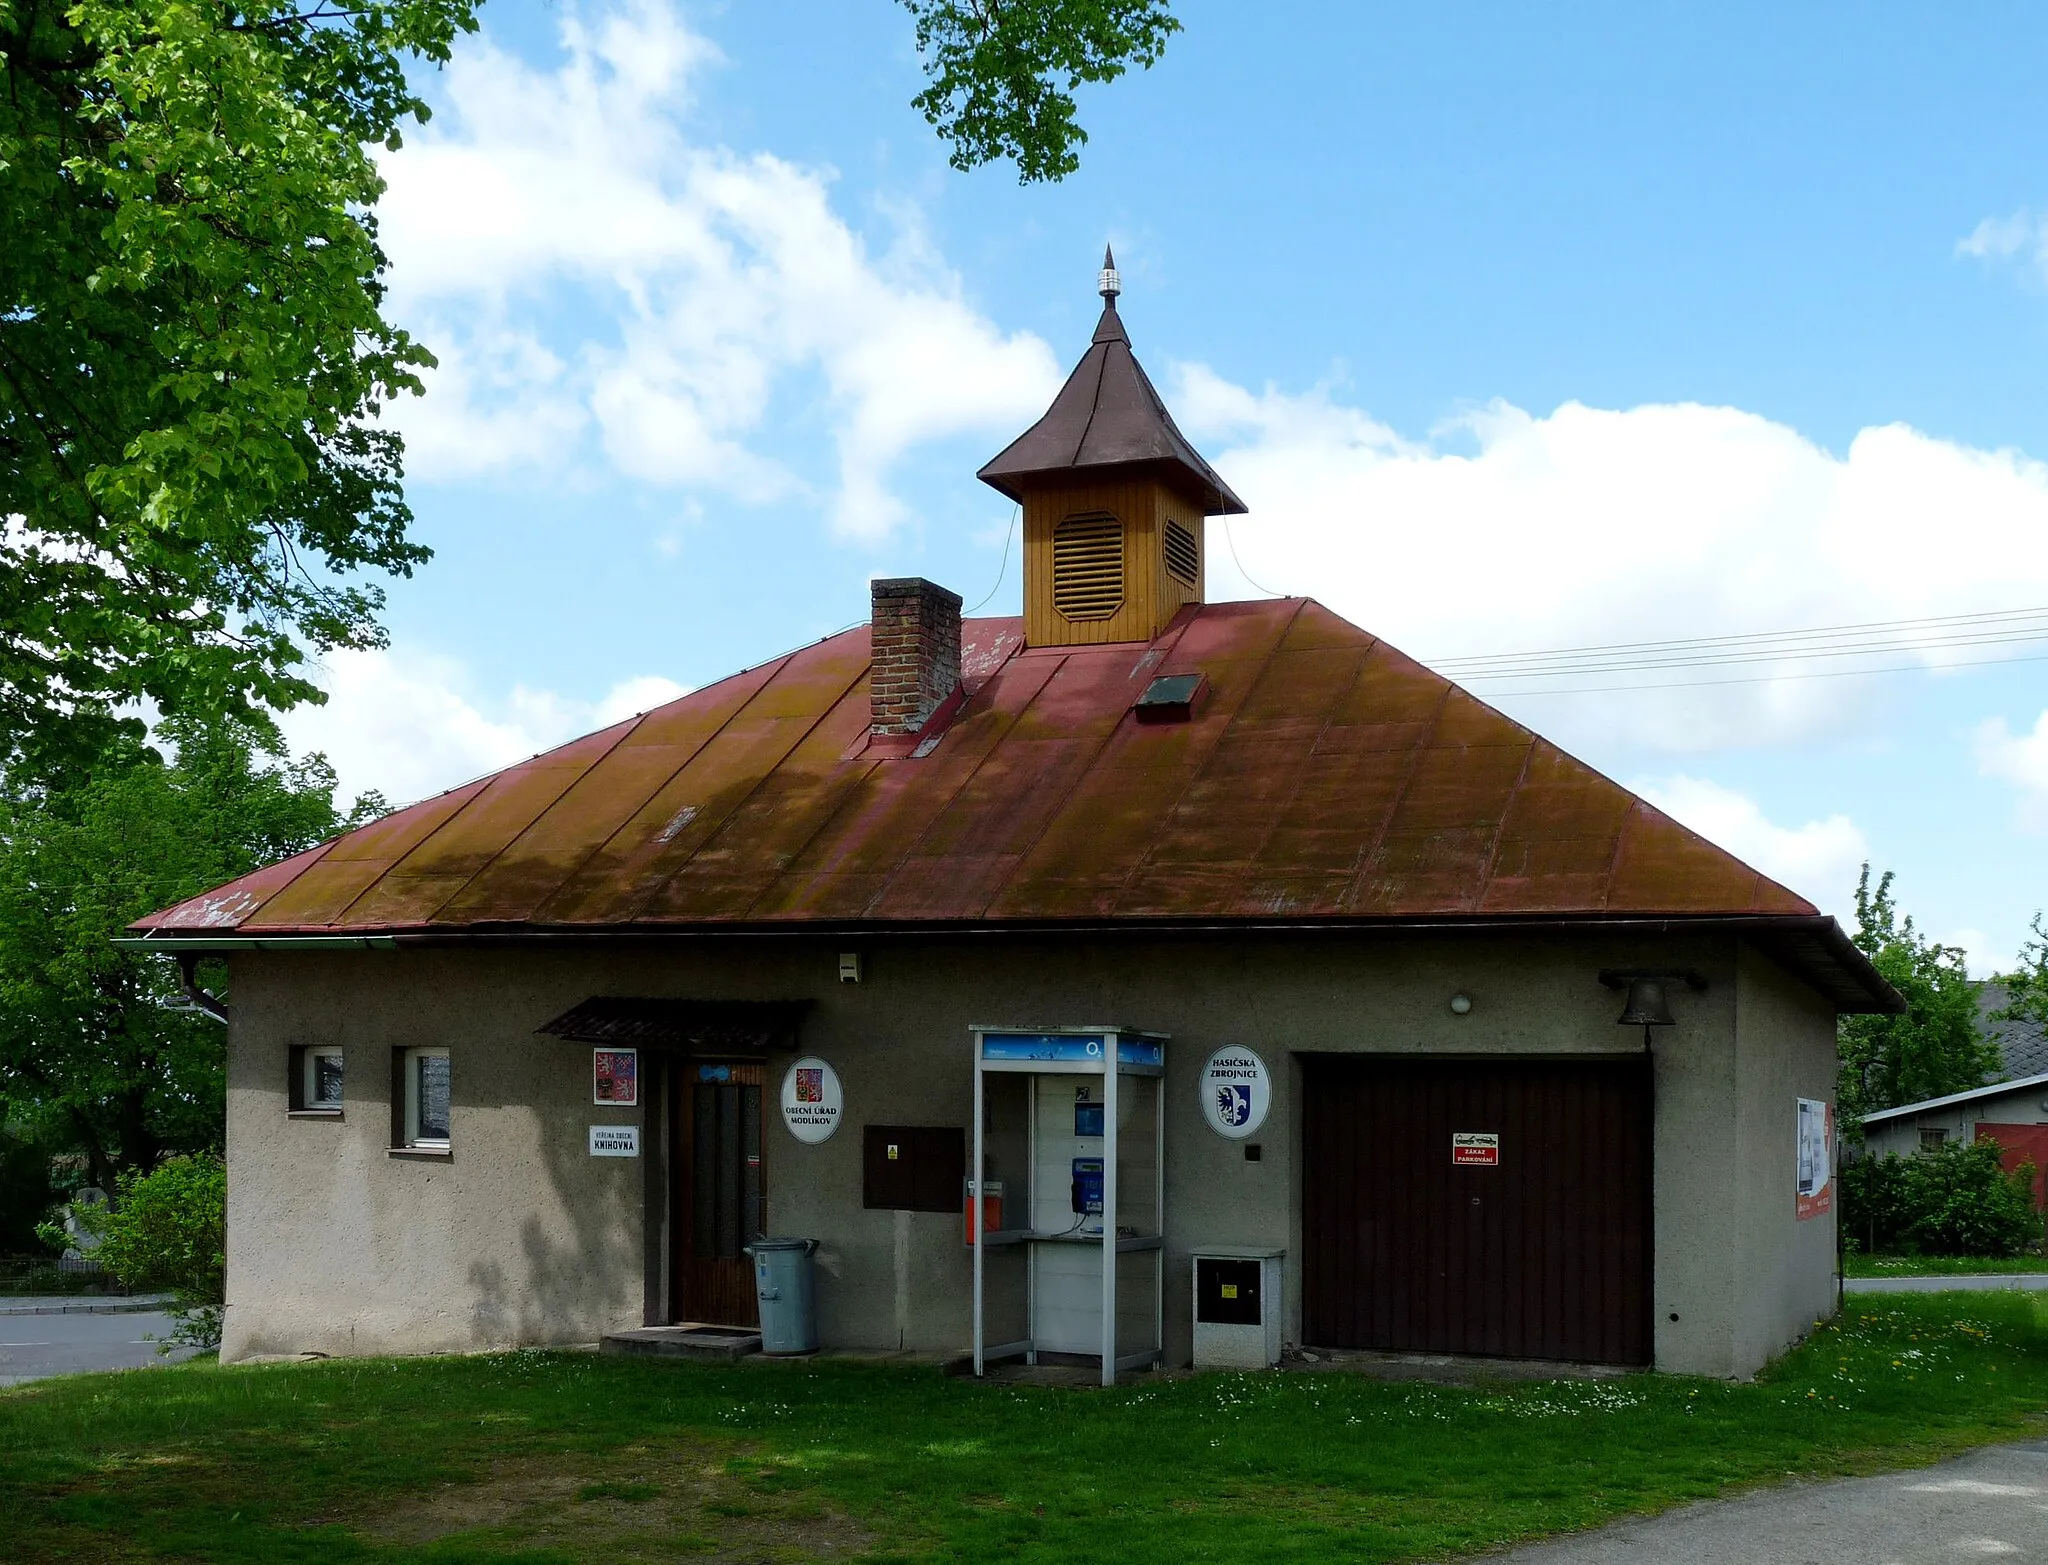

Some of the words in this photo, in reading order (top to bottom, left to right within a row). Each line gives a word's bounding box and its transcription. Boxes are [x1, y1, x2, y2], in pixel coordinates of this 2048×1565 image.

[1210, 1069, 1258, 1079] ZBROJNICE
[785, 1106, 812, 1115] OBECNÍ
[814, 1105, 837, 1115] ÚŘAD
[790, 1116, 832, 1125] MODLÍKOV
[594, 1140, 634, 1151] KNIHOVNA
